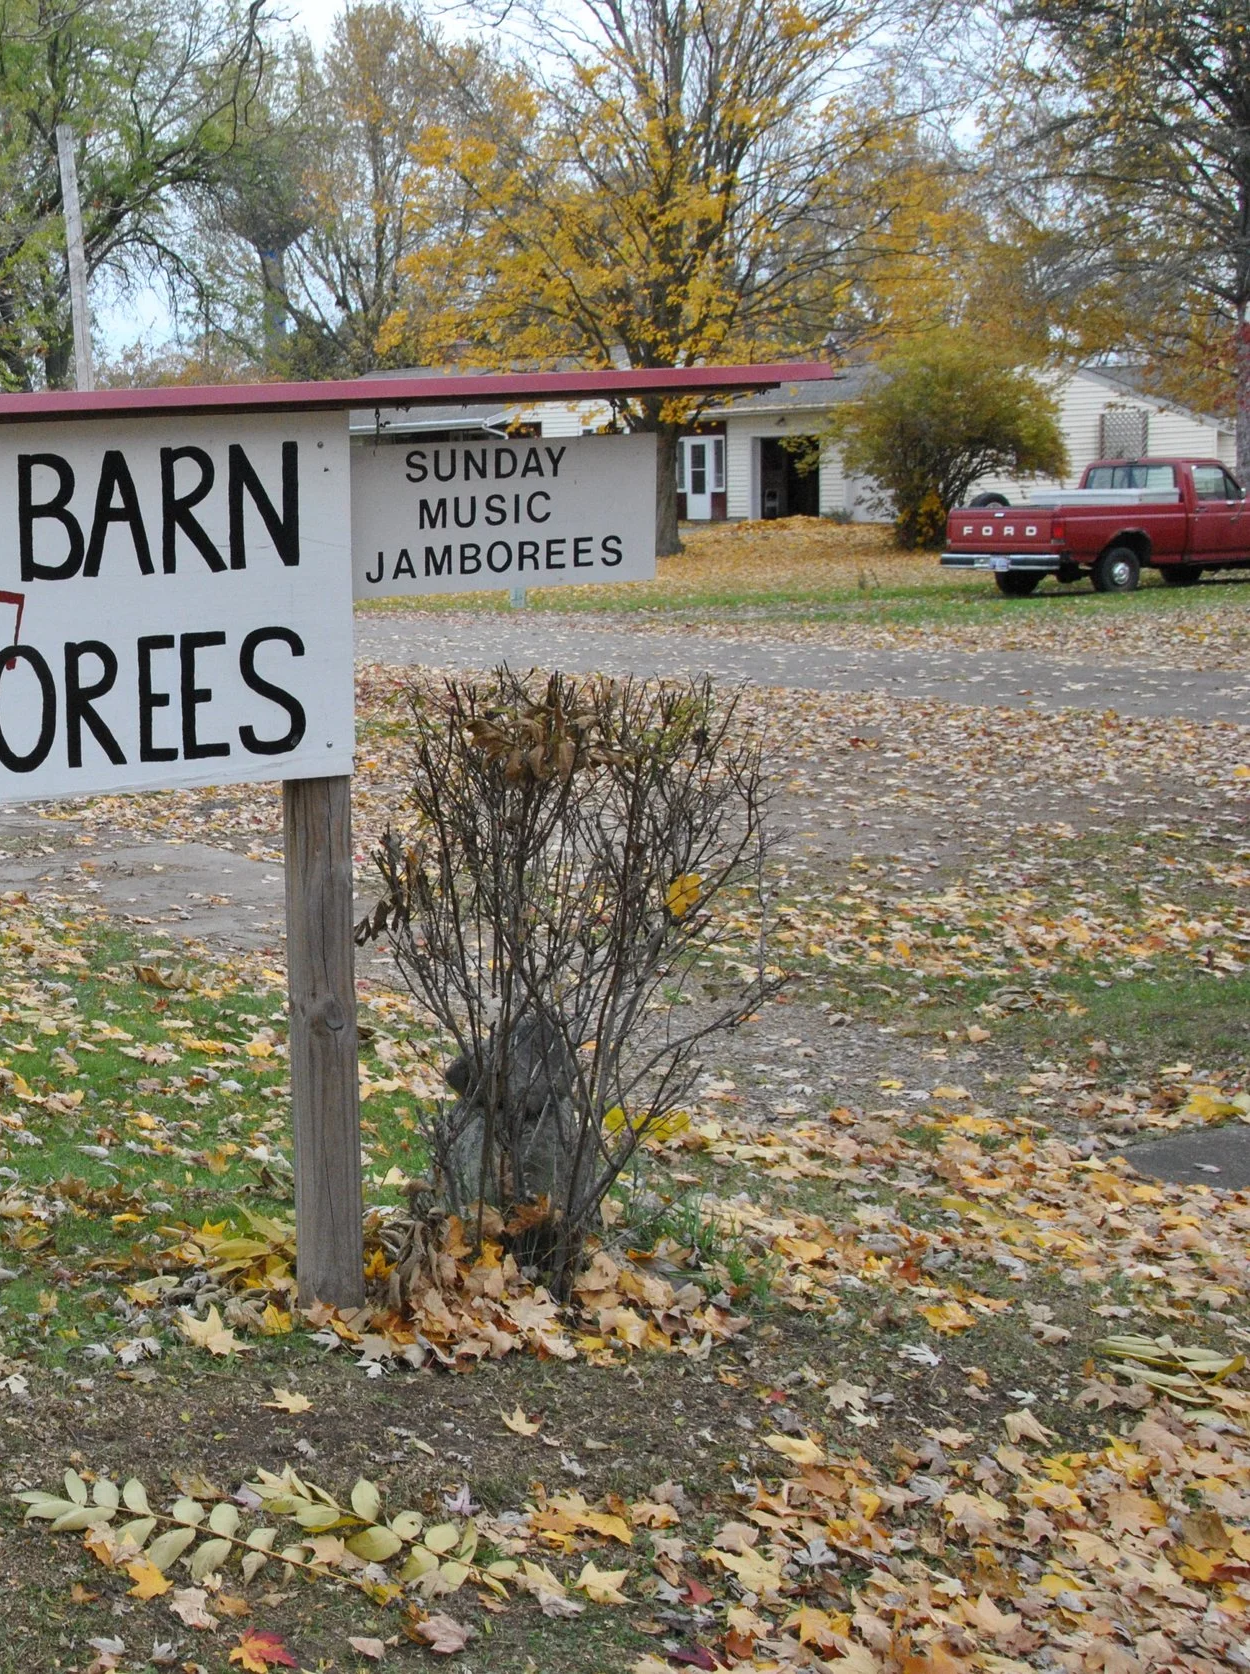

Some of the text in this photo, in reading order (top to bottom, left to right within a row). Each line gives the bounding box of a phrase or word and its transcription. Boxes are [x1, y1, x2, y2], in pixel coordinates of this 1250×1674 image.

[405, 445, 567, 484] SUNDAY
[17, 440, 300, 583] BARN
[419, 490, 552, 530] MUSIC
[963, 526, 1037, 536] FORD
[365, 535, 623, 584] JAMBOREES
